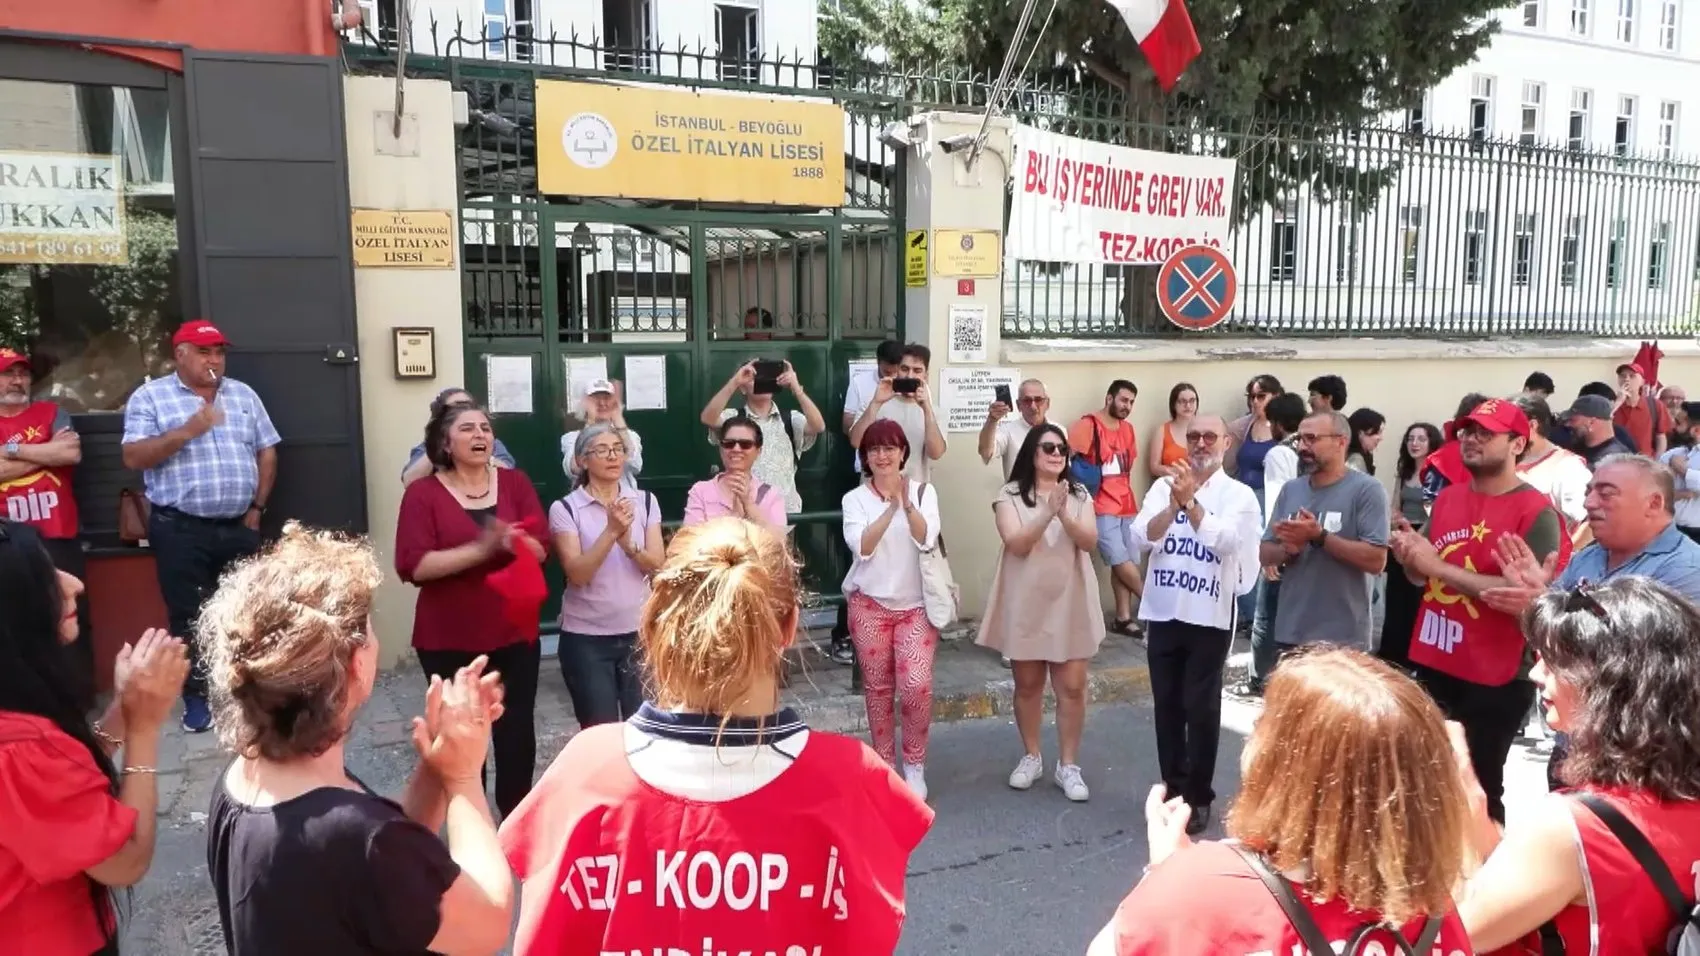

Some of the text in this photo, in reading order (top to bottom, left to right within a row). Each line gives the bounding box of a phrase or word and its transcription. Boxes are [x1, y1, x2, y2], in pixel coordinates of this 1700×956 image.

[655, 111, 726, 132] İSTANBUL
[739, 119, 802, 136] BEYOĞLU
[632, 130, 824, 161] ÖZEL İTALYAN LİSESİ
[793, 167, 824, 178] 1888
[1025, 150, 1050, 194] BU
[1147, 173, 1192, 218] GREV
[355, 235, 449, 248] ÖZEL İTALYAN
[384, 251, 423, 262] LİSESİ
[7, 488, 58, 523] DİP
[1419, 610, 1464, 654] DİP
[655, 848, 789, 912] KOOP
